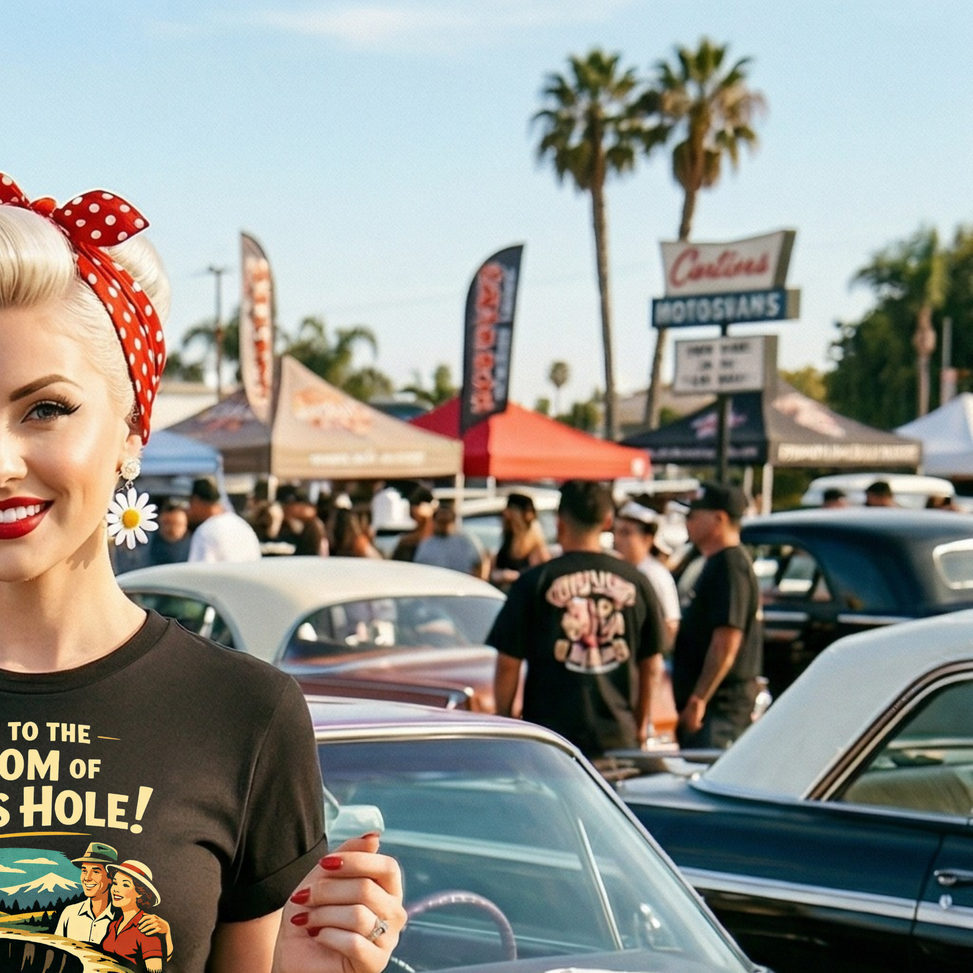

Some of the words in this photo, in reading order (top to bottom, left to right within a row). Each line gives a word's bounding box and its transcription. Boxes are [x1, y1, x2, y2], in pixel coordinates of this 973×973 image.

[7, 721, 39, 742] TO
[45, 722, 91, 744] THE
[69, 758, 102, 779] OF
[19, 785, 154, 834] HOLE!
